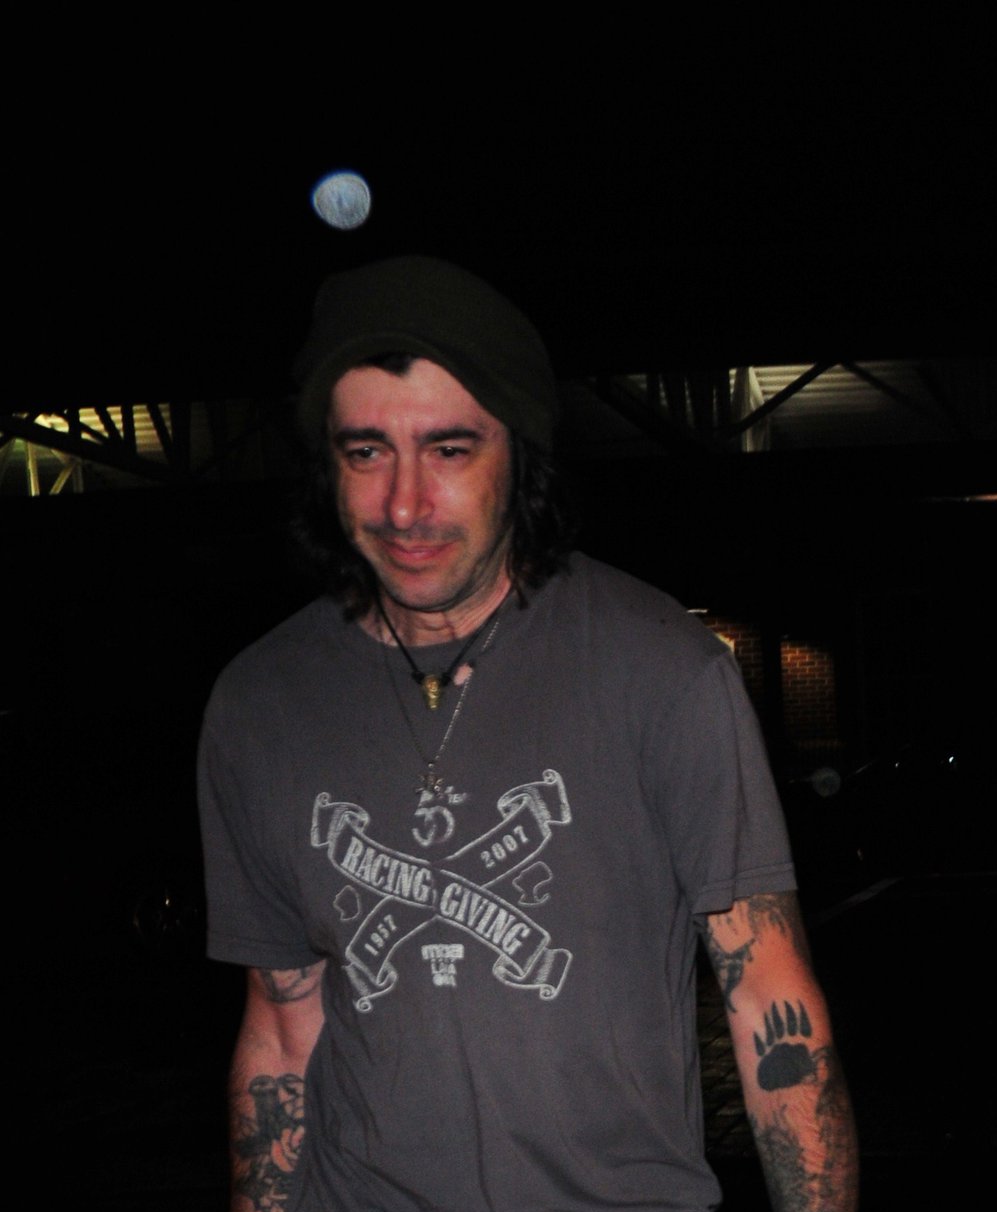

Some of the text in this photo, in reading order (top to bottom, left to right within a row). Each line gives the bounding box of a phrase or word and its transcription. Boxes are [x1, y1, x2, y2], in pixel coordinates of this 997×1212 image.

[480, 825, 530, 868] 2007
[341, 836, 530, 955] RACING GIVING
[364, 914, 398, 956] 1957
